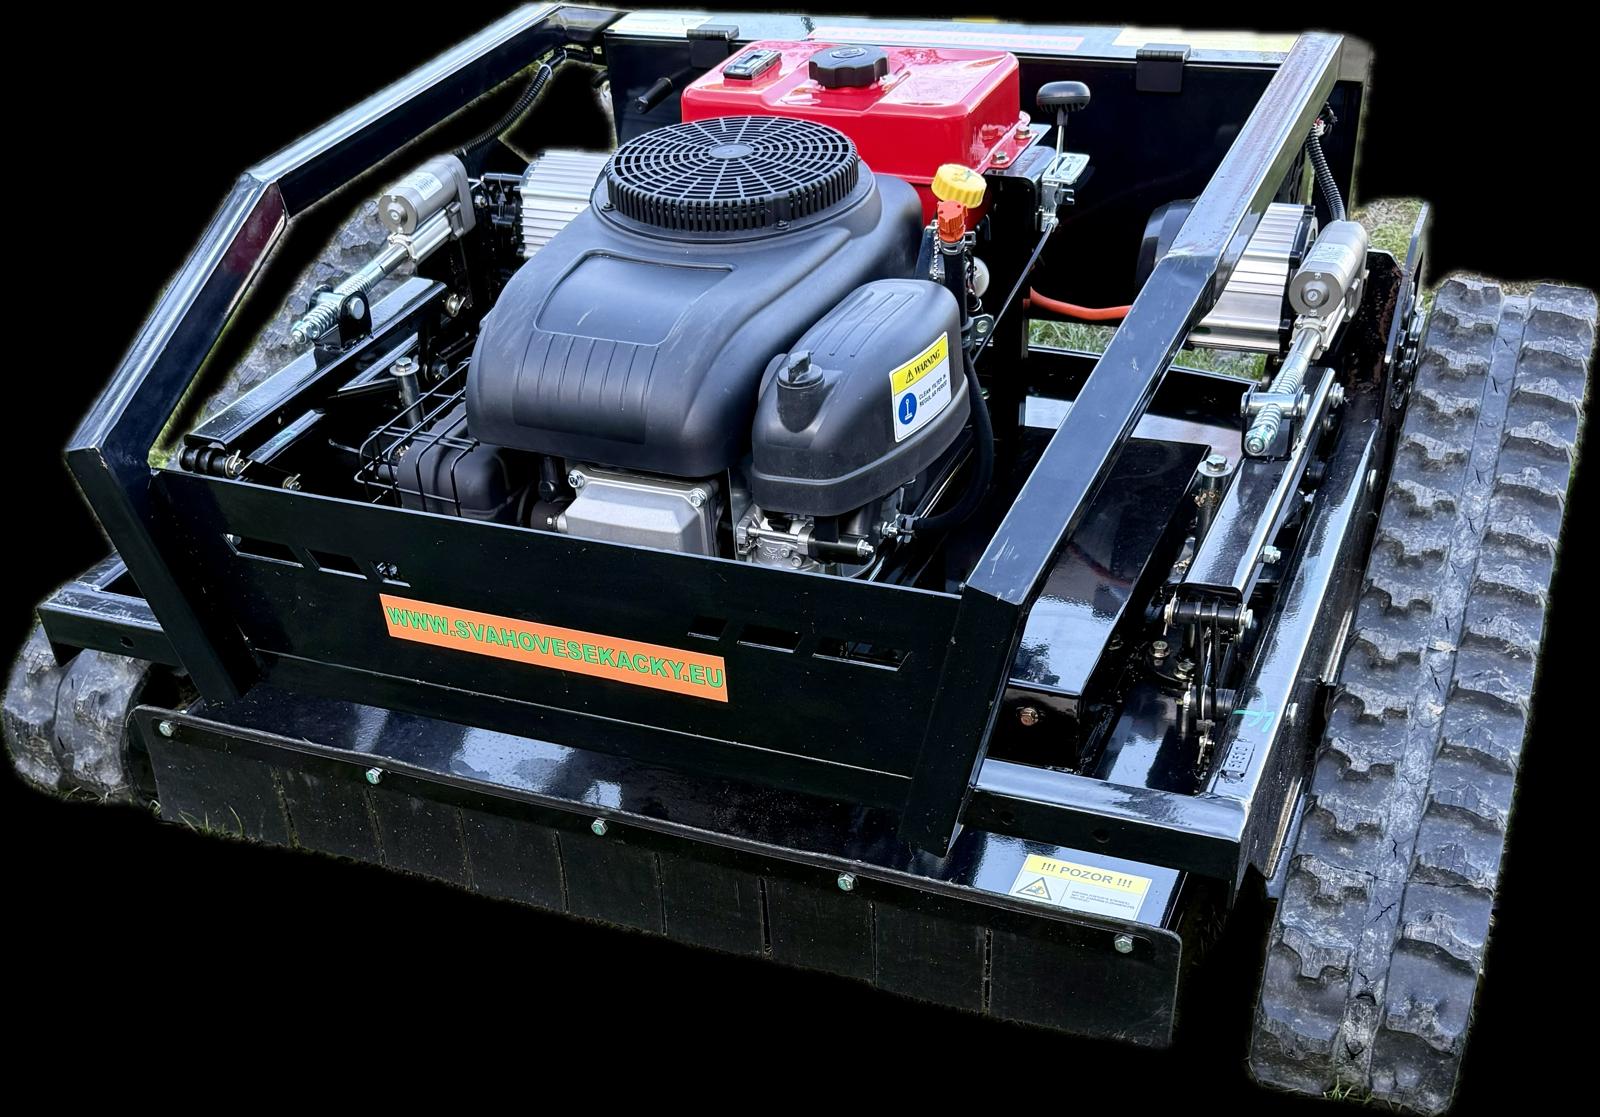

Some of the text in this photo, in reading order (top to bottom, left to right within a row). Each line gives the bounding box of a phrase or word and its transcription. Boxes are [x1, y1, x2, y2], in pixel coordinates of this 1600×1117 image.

[914, 350, 940, 375] WARNING
[919, 387, 931, 400] CLEAN
[386, 606, 723, 688] WWW.SVAHOVESEKACKY.EU
[1060, 866, 1113, 884] POZOR
